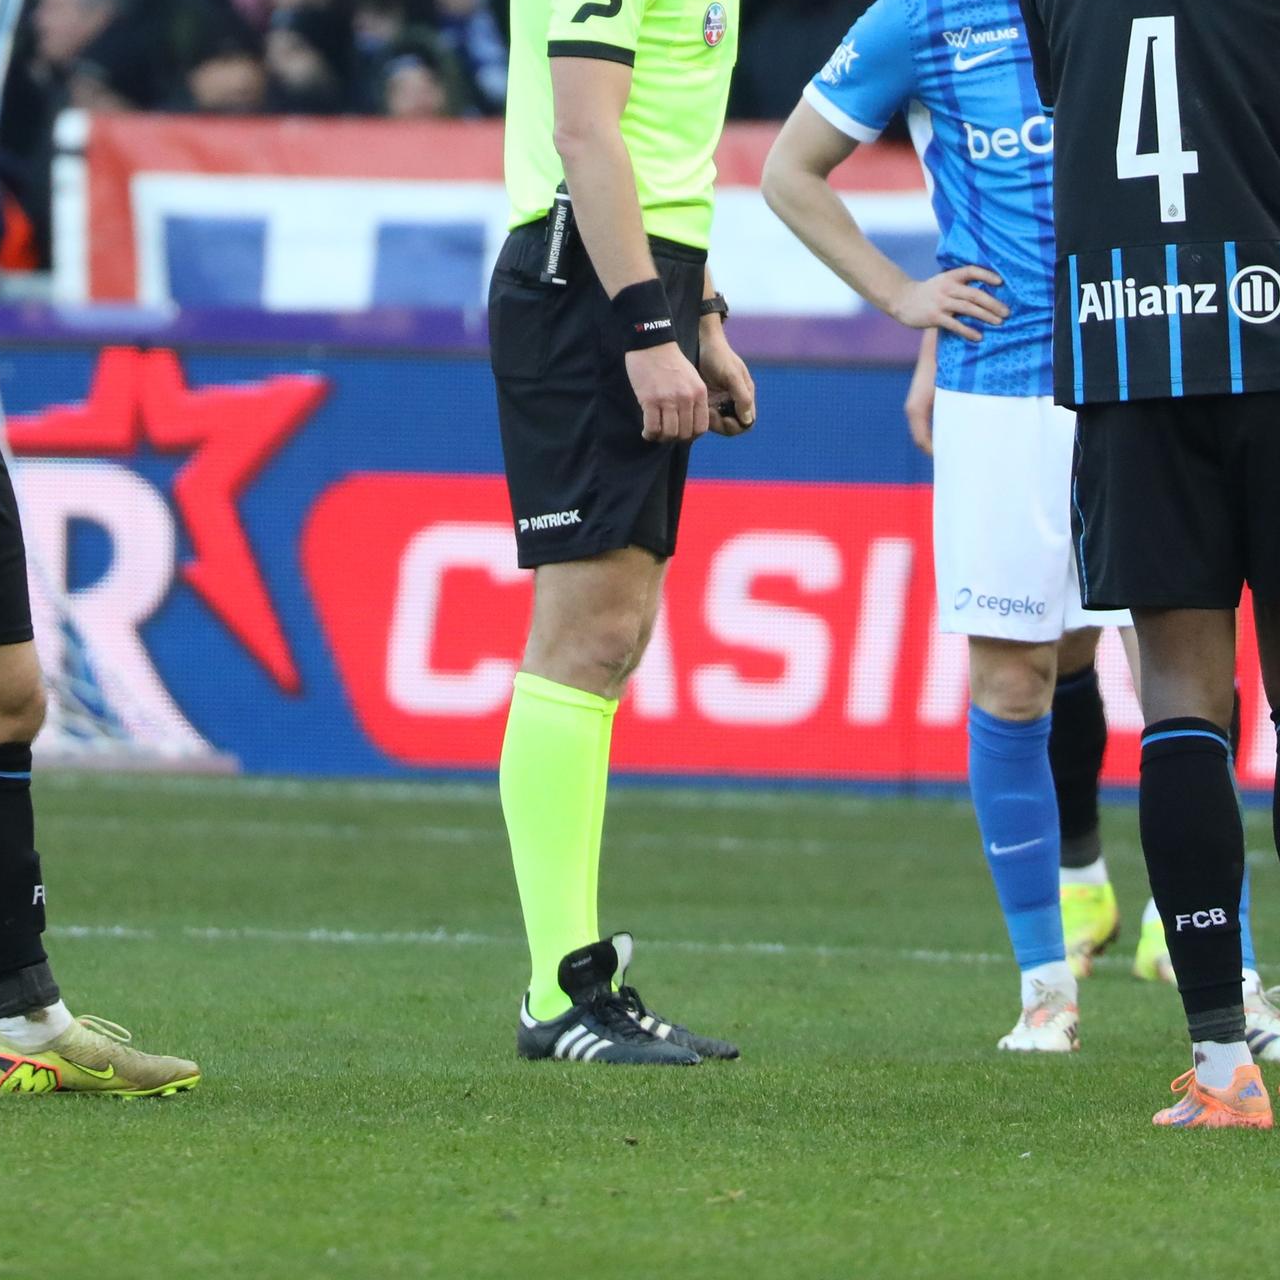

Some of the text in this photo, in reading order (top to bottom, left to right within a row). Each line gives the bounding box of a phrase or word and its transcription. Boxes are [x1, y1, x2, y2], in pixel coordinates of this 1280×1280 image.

[971, 27, 1018, 45] WILMS
[1116, 16, 1199, 223] 4
[547, 205, 568, 274] VANISHING SPRAY
[1078, 278, 1218, 323] Allianz
[530, 509, 582, 531] PATRICK
[1176, 908, 1227, 932] FCB
